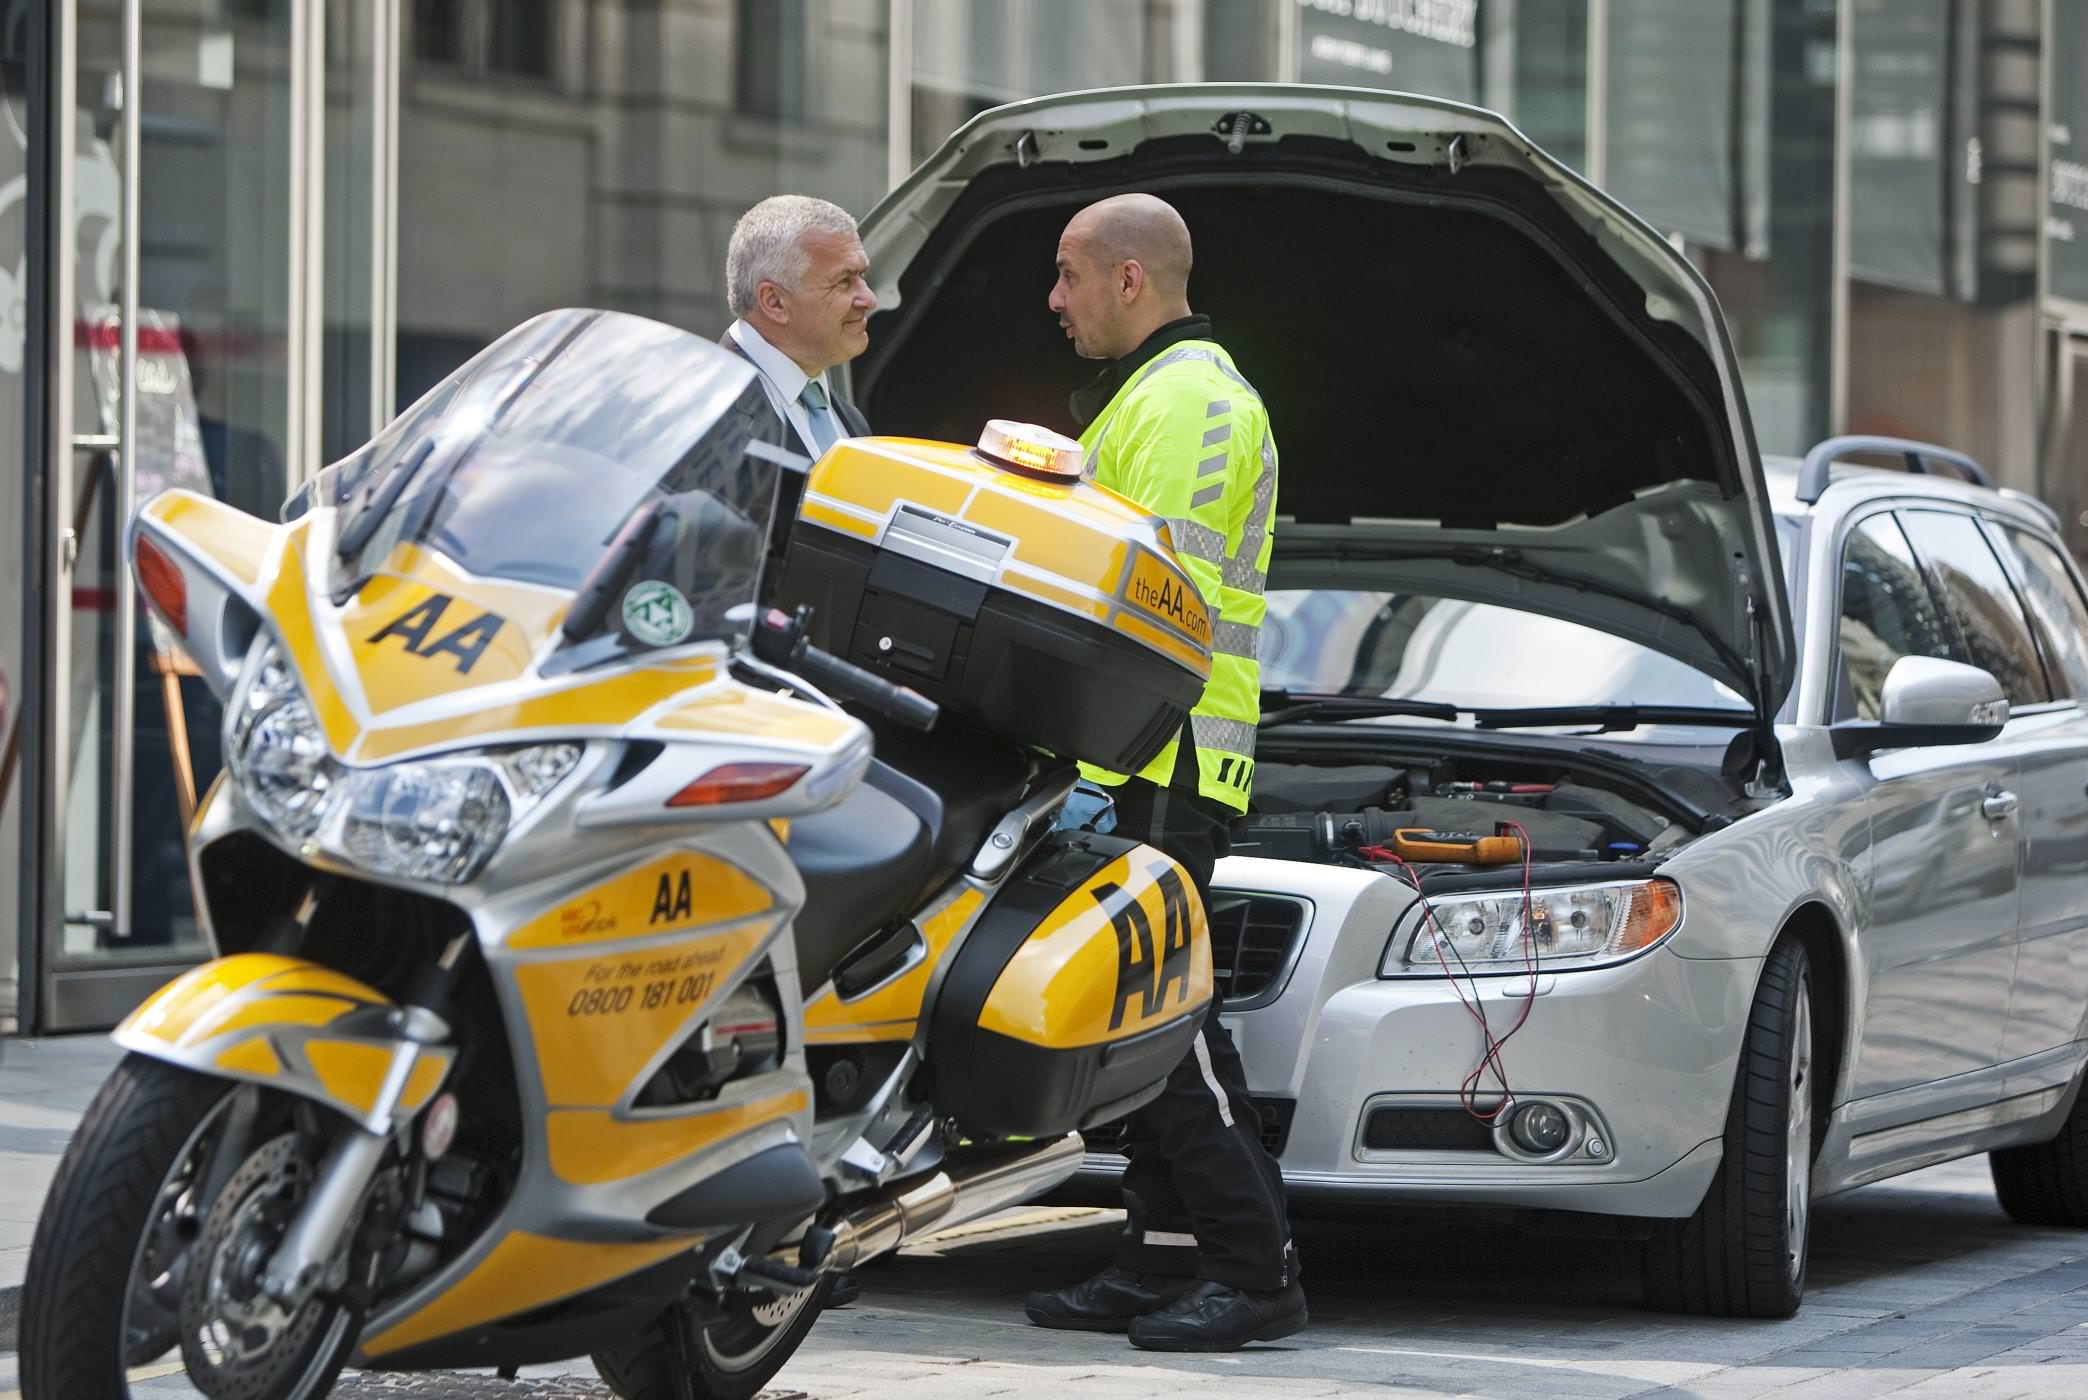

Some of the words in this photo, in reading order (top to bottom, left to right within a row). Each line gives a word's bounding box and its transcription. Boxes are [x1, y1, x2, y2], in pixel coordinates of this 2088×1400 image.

[366, 593, 505, 675] AA
[1135, 576, 1208, 639] theAA.com
[649, 869, 692, 925] AA
[583, 961, 616, 983] For
[616, 960, 643, 979] the
[645, 956, 681, 977] road
[1090, 868, 1192, 1032] AA
[567, 984, 635, 1017] 0800
[639, 977, 676, 1010] 181
[677, 969, 715, 1004] 001
